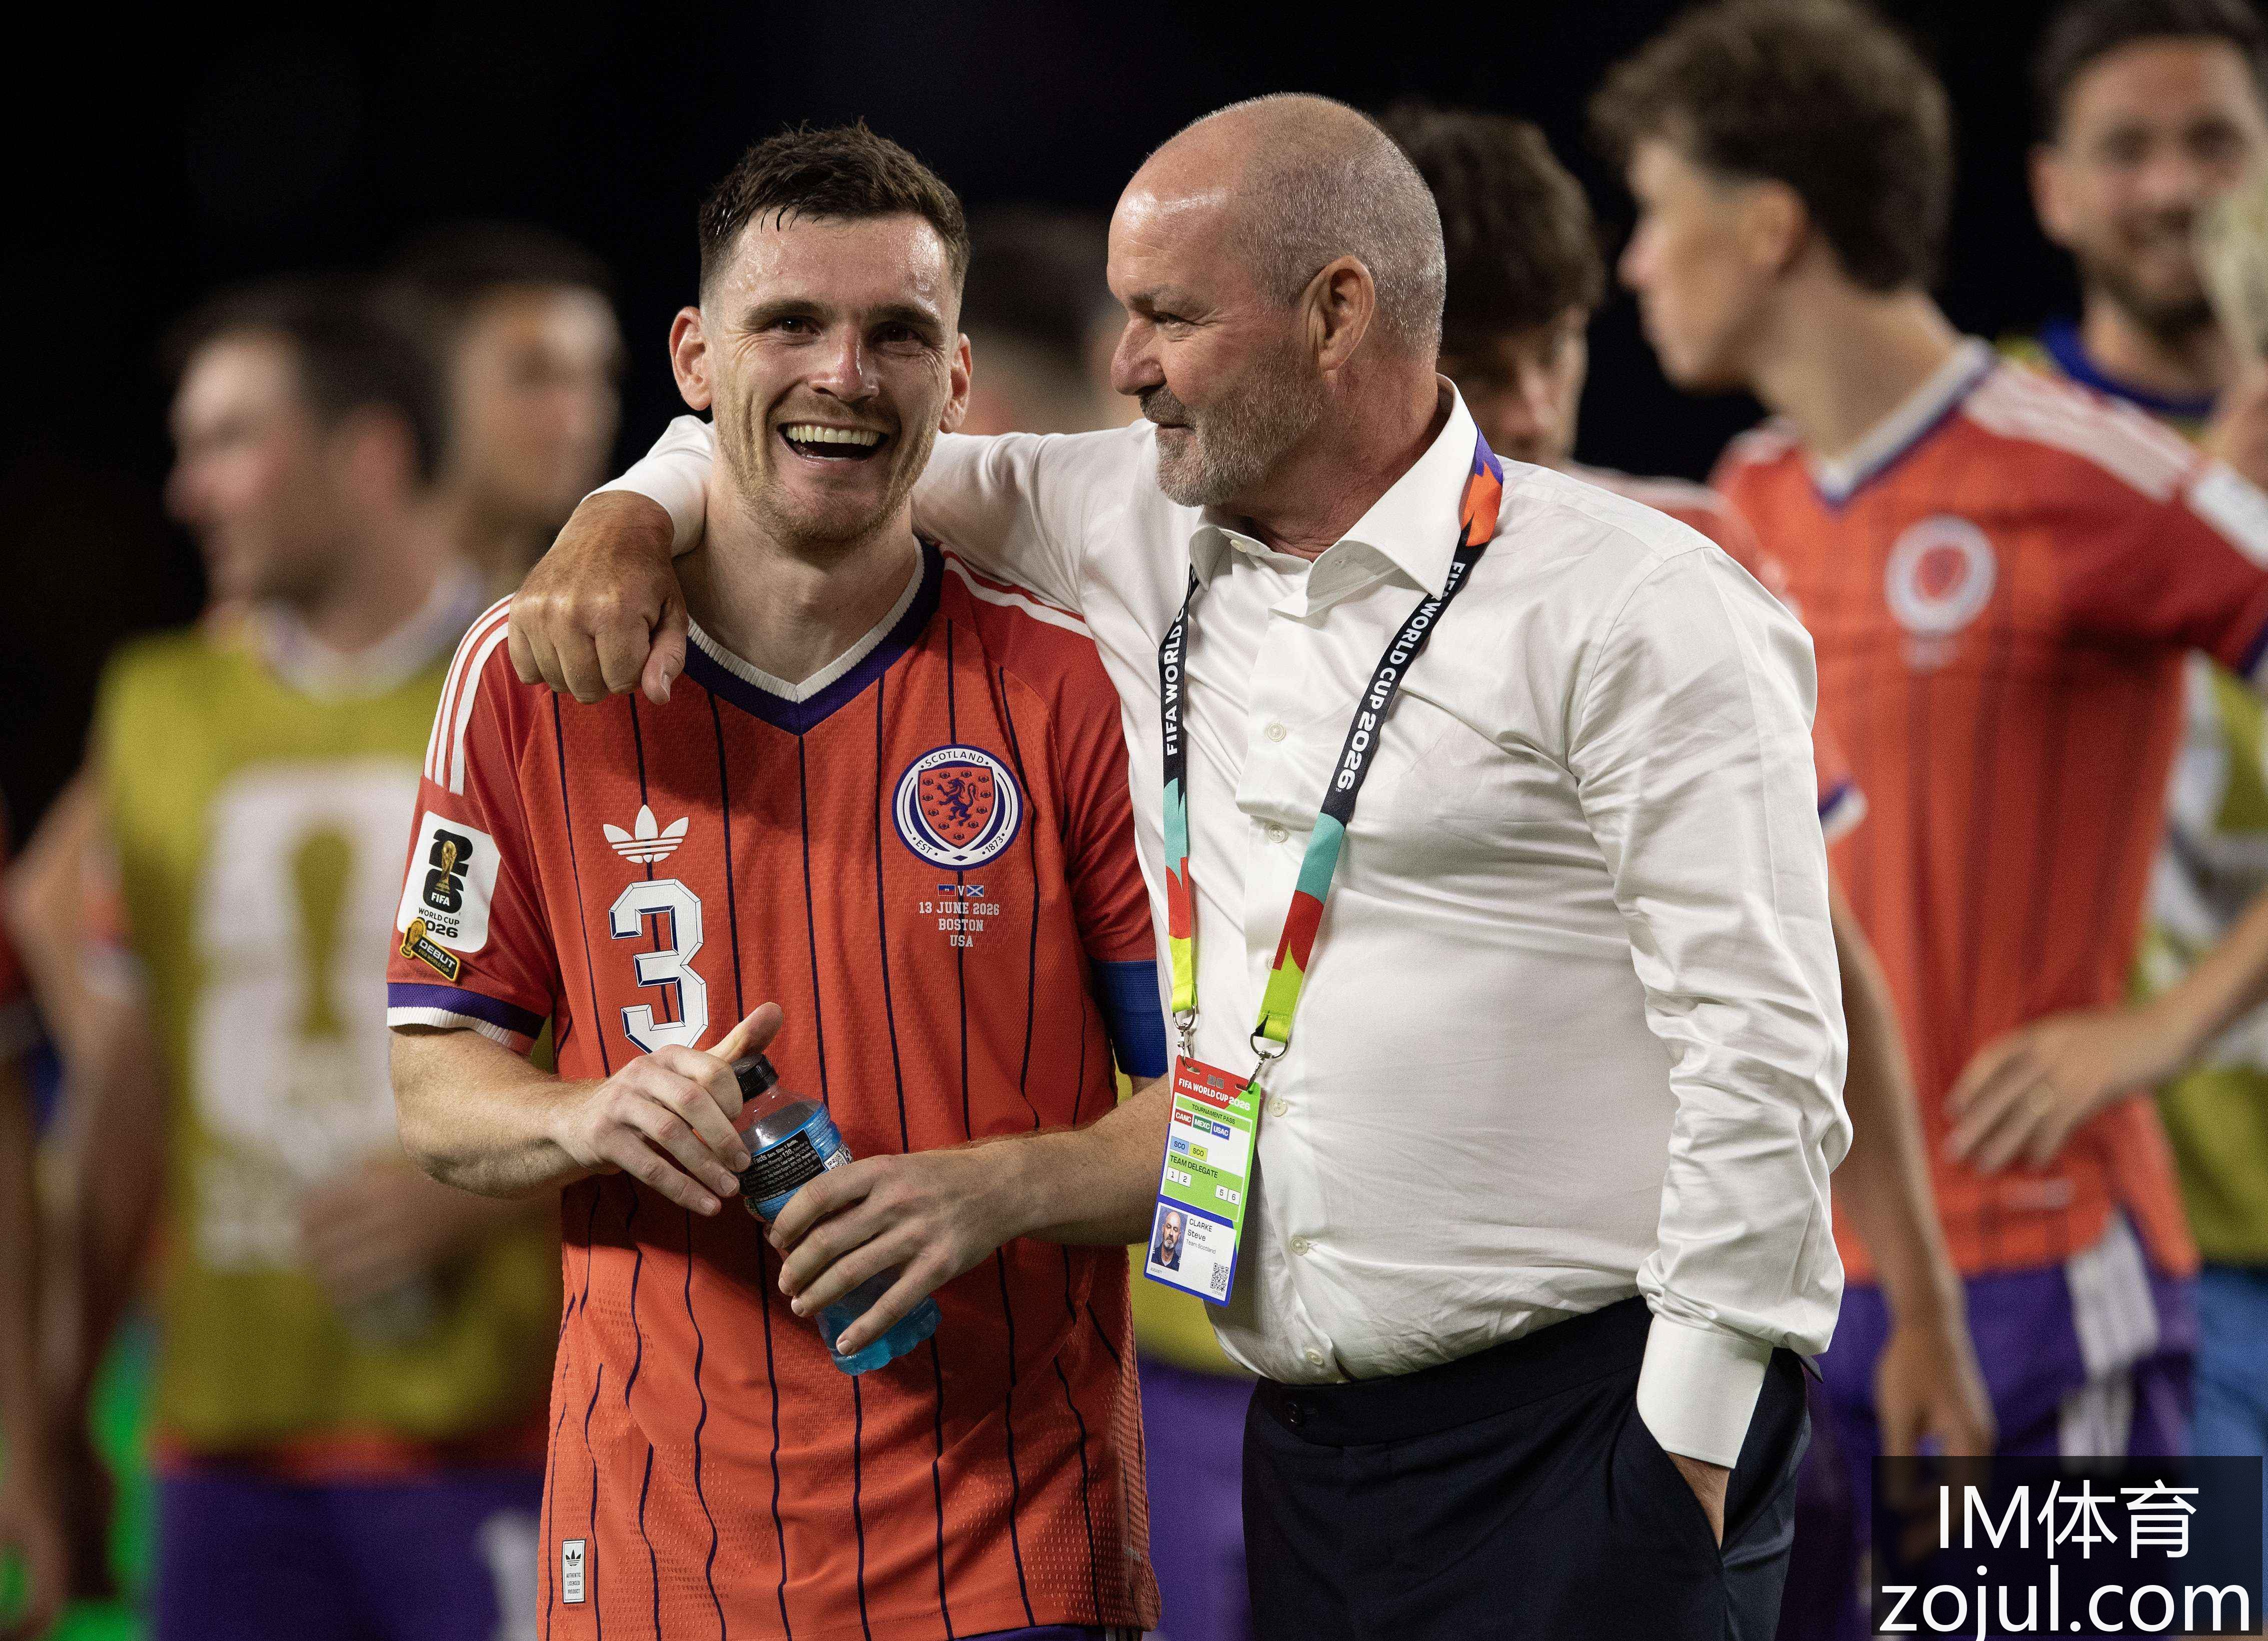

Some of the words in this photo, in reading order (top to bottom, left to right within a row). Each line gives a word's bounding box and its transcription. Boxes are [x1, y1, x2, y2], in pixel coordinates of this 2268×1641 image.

[1390, 602, 1441, 664] WORLD
[1164, 625, 1182, 704] WORLD
[1369, 668, 1396, 710] CUP
[1166, 705, 1177, 756] FIFA
[925, 751, 984, 767] SCOTLAND
[1337, 711, 1376, 790] 2026
[916, 840, 932, 854] EST
[985, 836, 1004, 853] 1873
[431, 892, 450, 906] FIFA
[419, 908, 442, 920] WORLD
[444, 917, 460, 926] CUP
[919, 902, 932, 914] 13
[936, 902, 969, 914] JUNE
[973, 902, 1000, 916] 2026
[417, 916, 458, 938] 026
[938, 918, 984, 932] BOSTON
[950, 935, 973, 947] USA
[419, 940, 455, 968] DEBUT
[609, 878, 708, 1054] 3
[1178, 1078, 1192, 1090] FIFA
[1193, 1082, 1215, 1098] WORLD
[1215, 1092, 1229, 1102] CUP
[1229, 1097, 1250, 1111] 2026
[1192, 1104, 1223, 1120] TOURNAMENT
[1223, 1116, 1235, 1124] PASS
[1194, 1118, 1210, 1130] MEXC
[1213, 1126, 1229, 1136] USAC
[1174, 1140, 1185, 1150] SCO
[1193, 1148, 1204, 1156] SCO
[1170, 1155, 1187, 1166] TEAM
[1188, 1162, 1218, 1178] DELEGATE
[1189, 1218, 1212, 1232] CLARKE
[1186, 1238, 1197, 1248] Team
[1187, 1230, 1206, 1242] Steve
